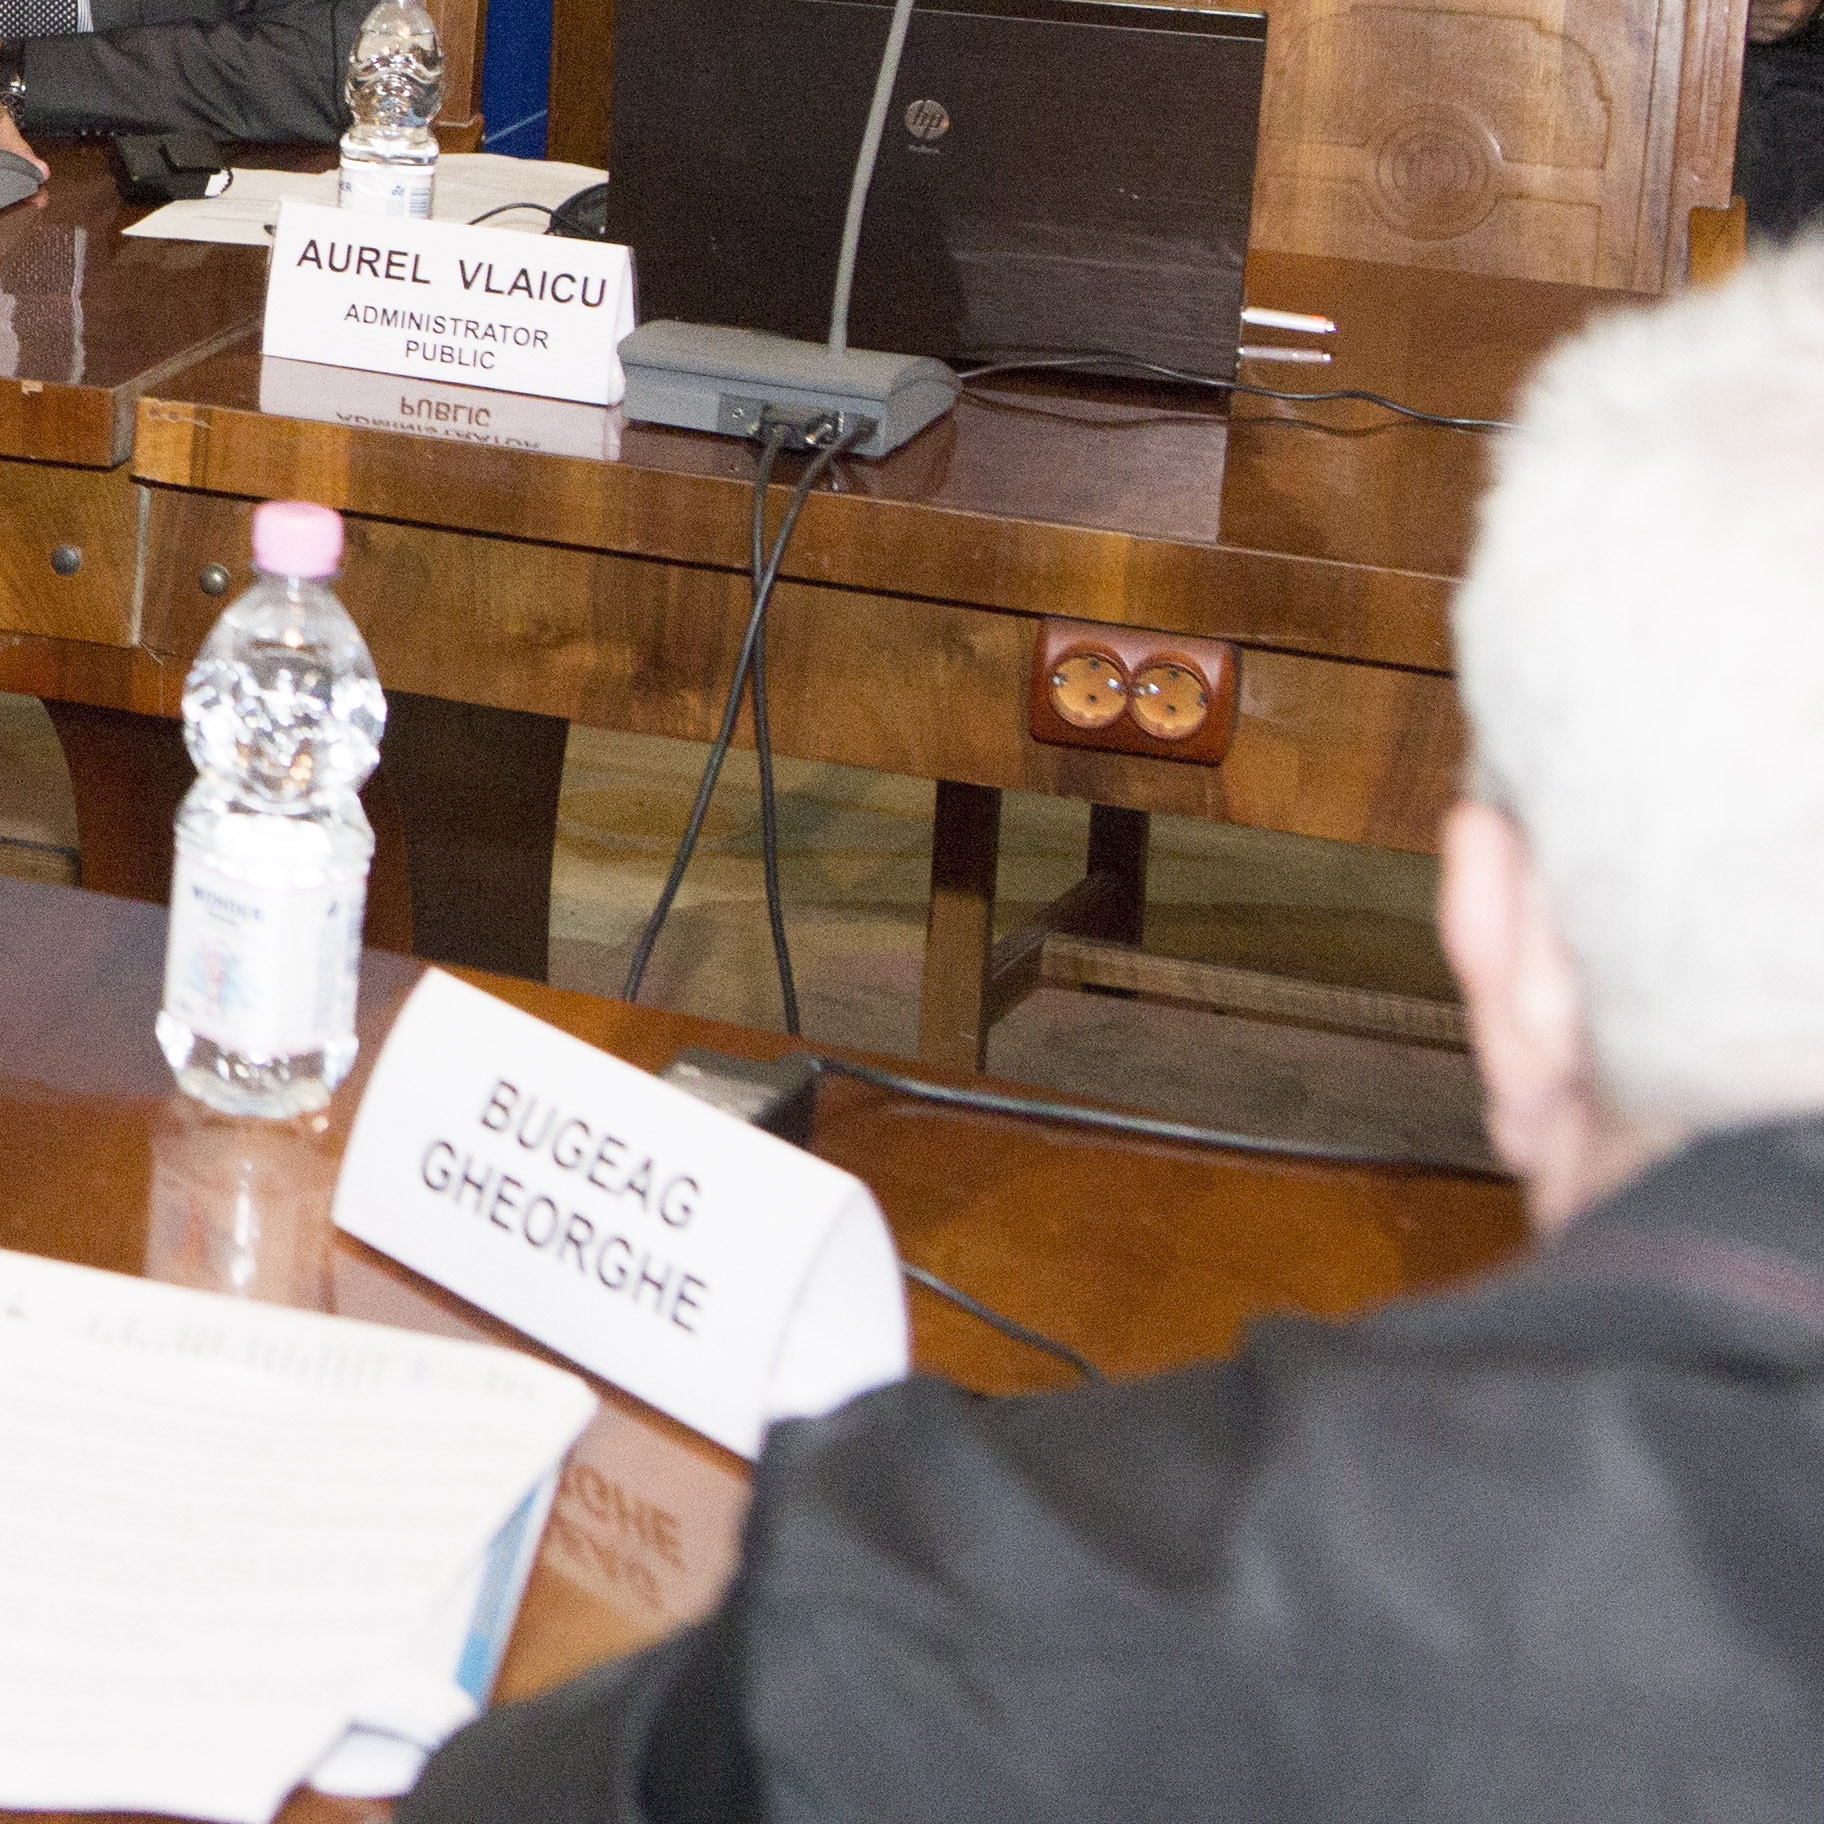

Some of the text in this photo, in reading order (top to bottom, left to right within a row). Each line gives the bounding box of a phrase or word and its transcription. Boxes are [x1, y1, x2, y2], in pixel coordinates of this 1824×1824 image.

[297, 239, 607, 308] AUREL VLAICU
[344, 304, 549, 349] ADMINISTRATOR
[405, 340, 496, 370] PUBLIC
[480, 1078, 703, 1230] BUGEAG
[419, 1139, 710, 1336] GHEORGHE
